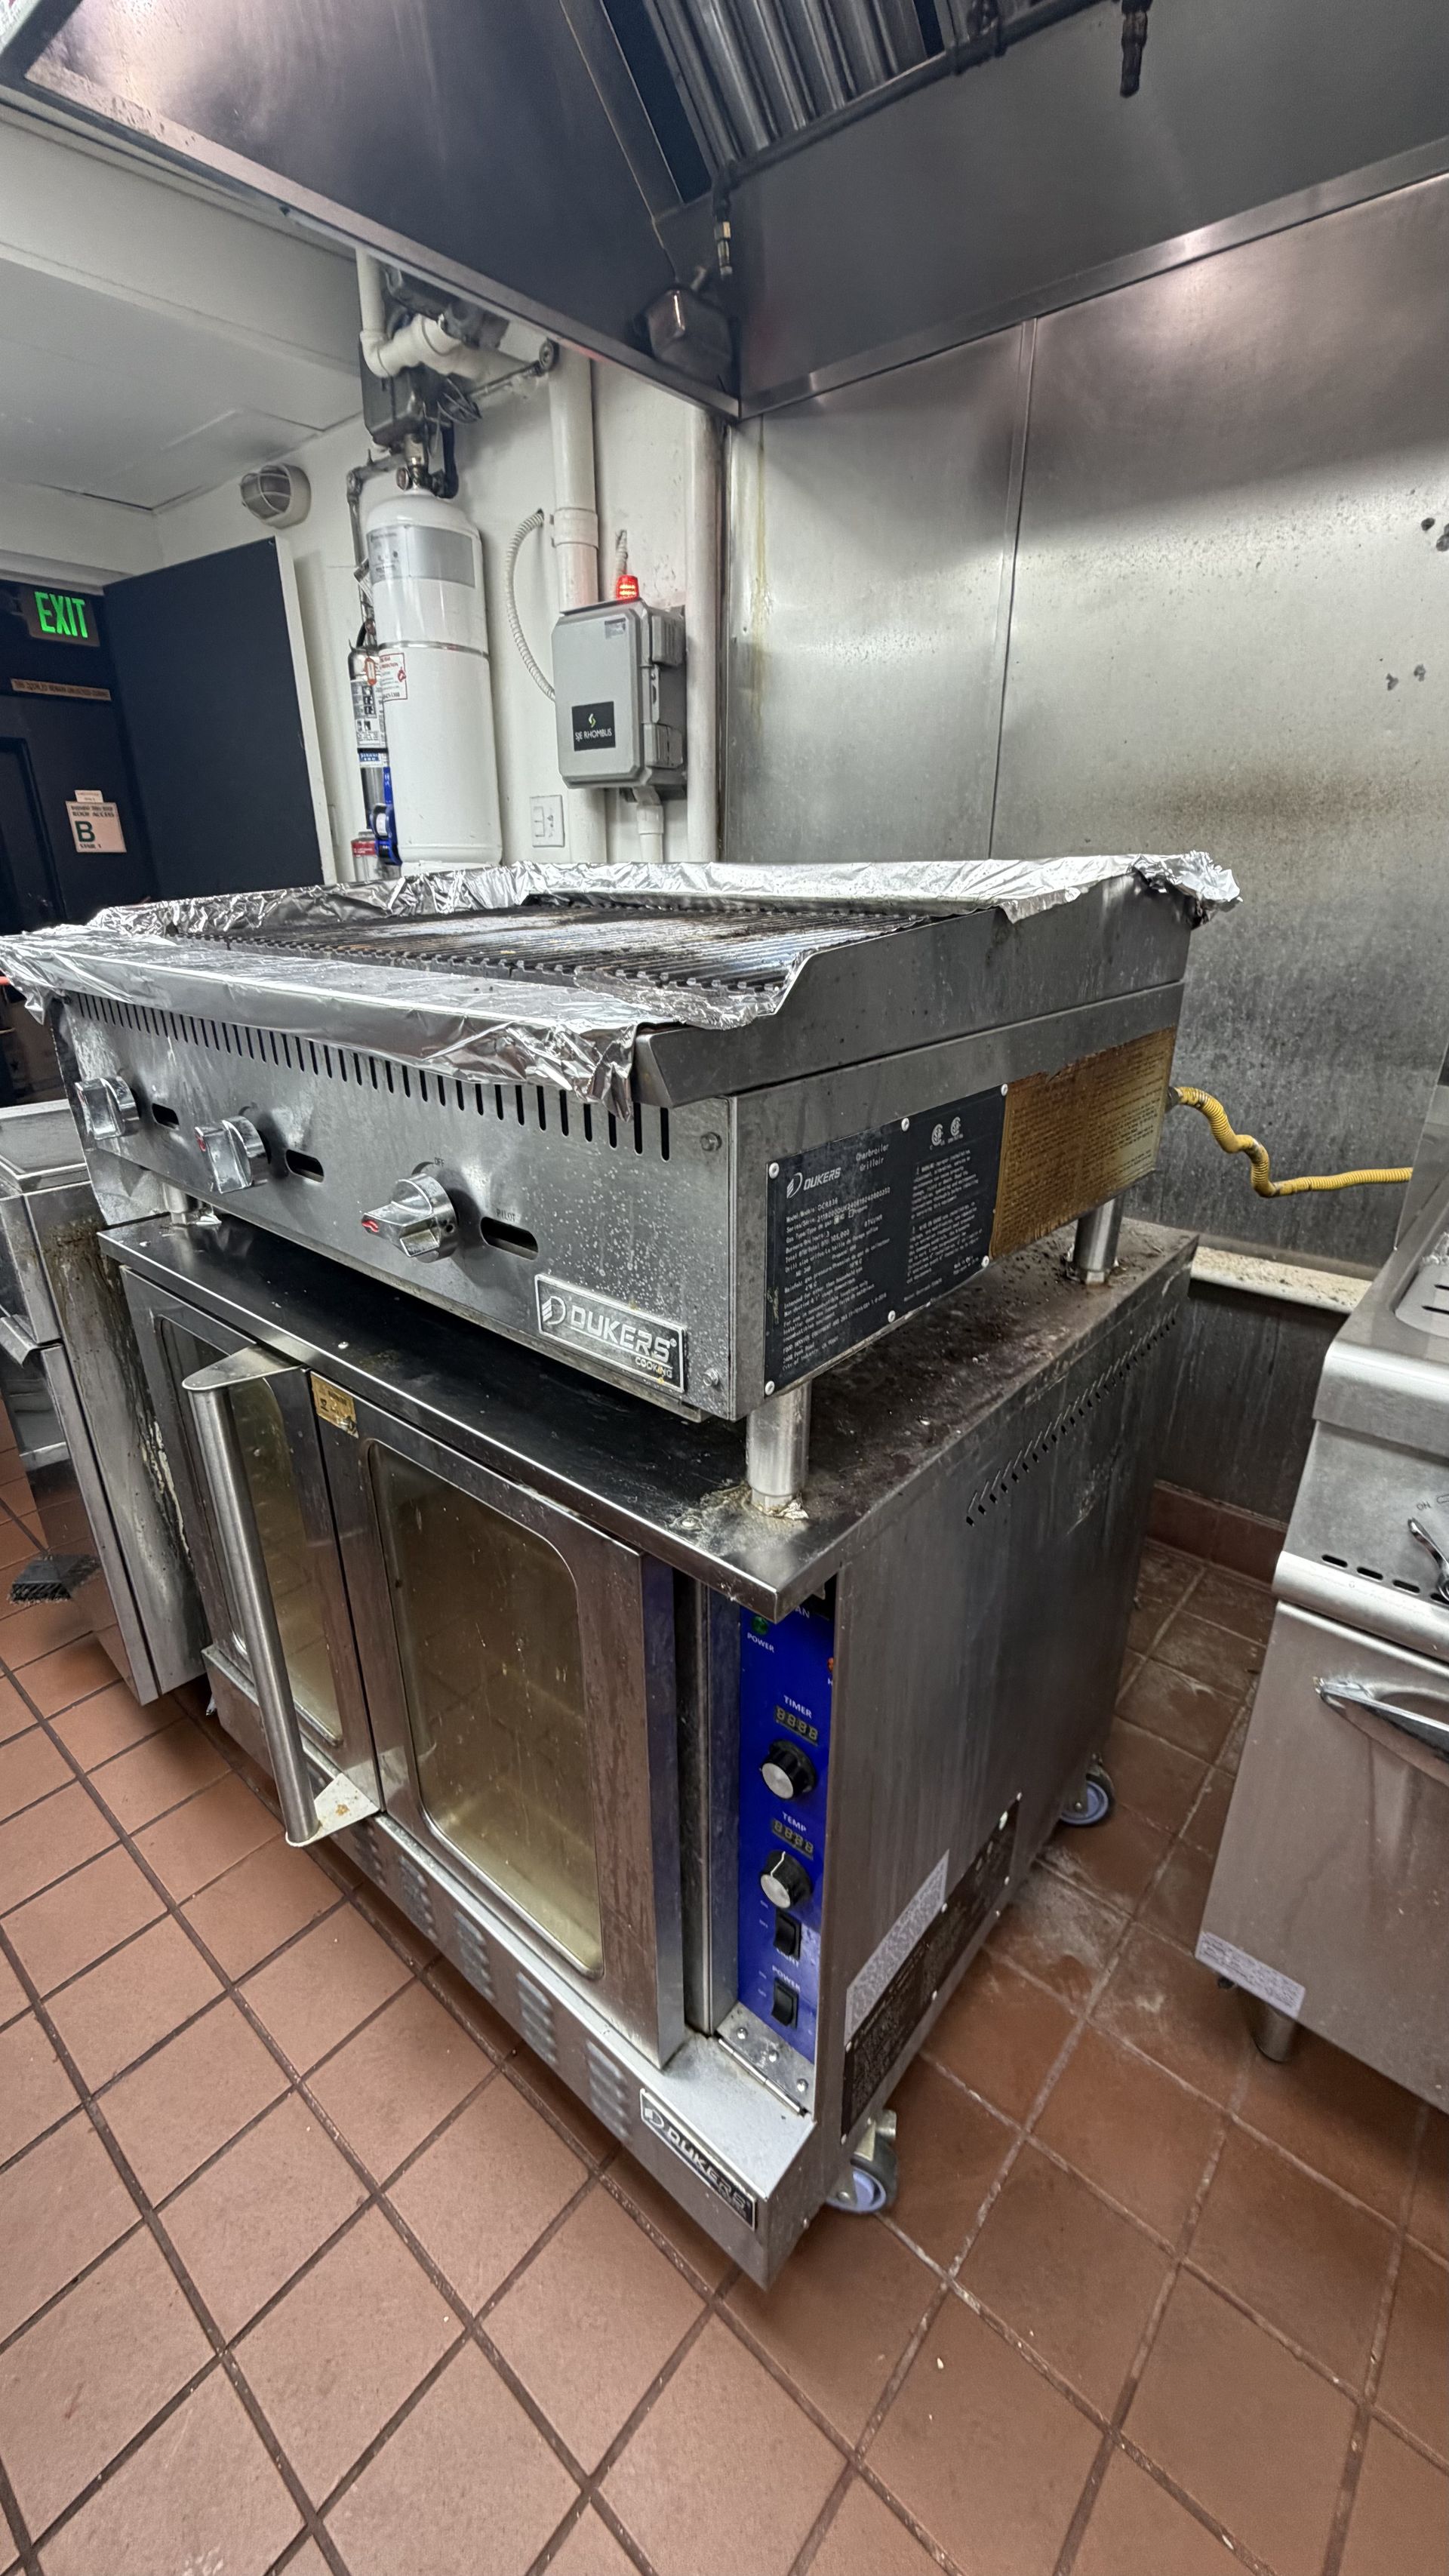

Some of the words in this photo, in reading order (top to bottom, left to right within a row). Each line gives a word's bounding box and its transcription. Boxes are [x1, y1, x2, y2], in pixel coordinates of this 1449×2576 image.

[35, 591, 88, 639] EXIT
[583, 728, 612, 740] RHOMBUS
[75, 820, 95, 842] B
[856, 1143, 889, 1162] Charbroiler
[803, 1167, 841, 1191] DUKERS
[571, 1305, 671, 1363] DUKERS
[635, 1356, 673, 1379] COOKING
[795, 1605, 810, 1619] AN
[746, 1632, 775, 1653] POWER
[783, 1694, 812, 1719] TIMER
[782, 1811, 807, 1832] TEMP
[771, 1965, 800, 1992] POWER
[667, 2126, 746, 2210] DUKERS
